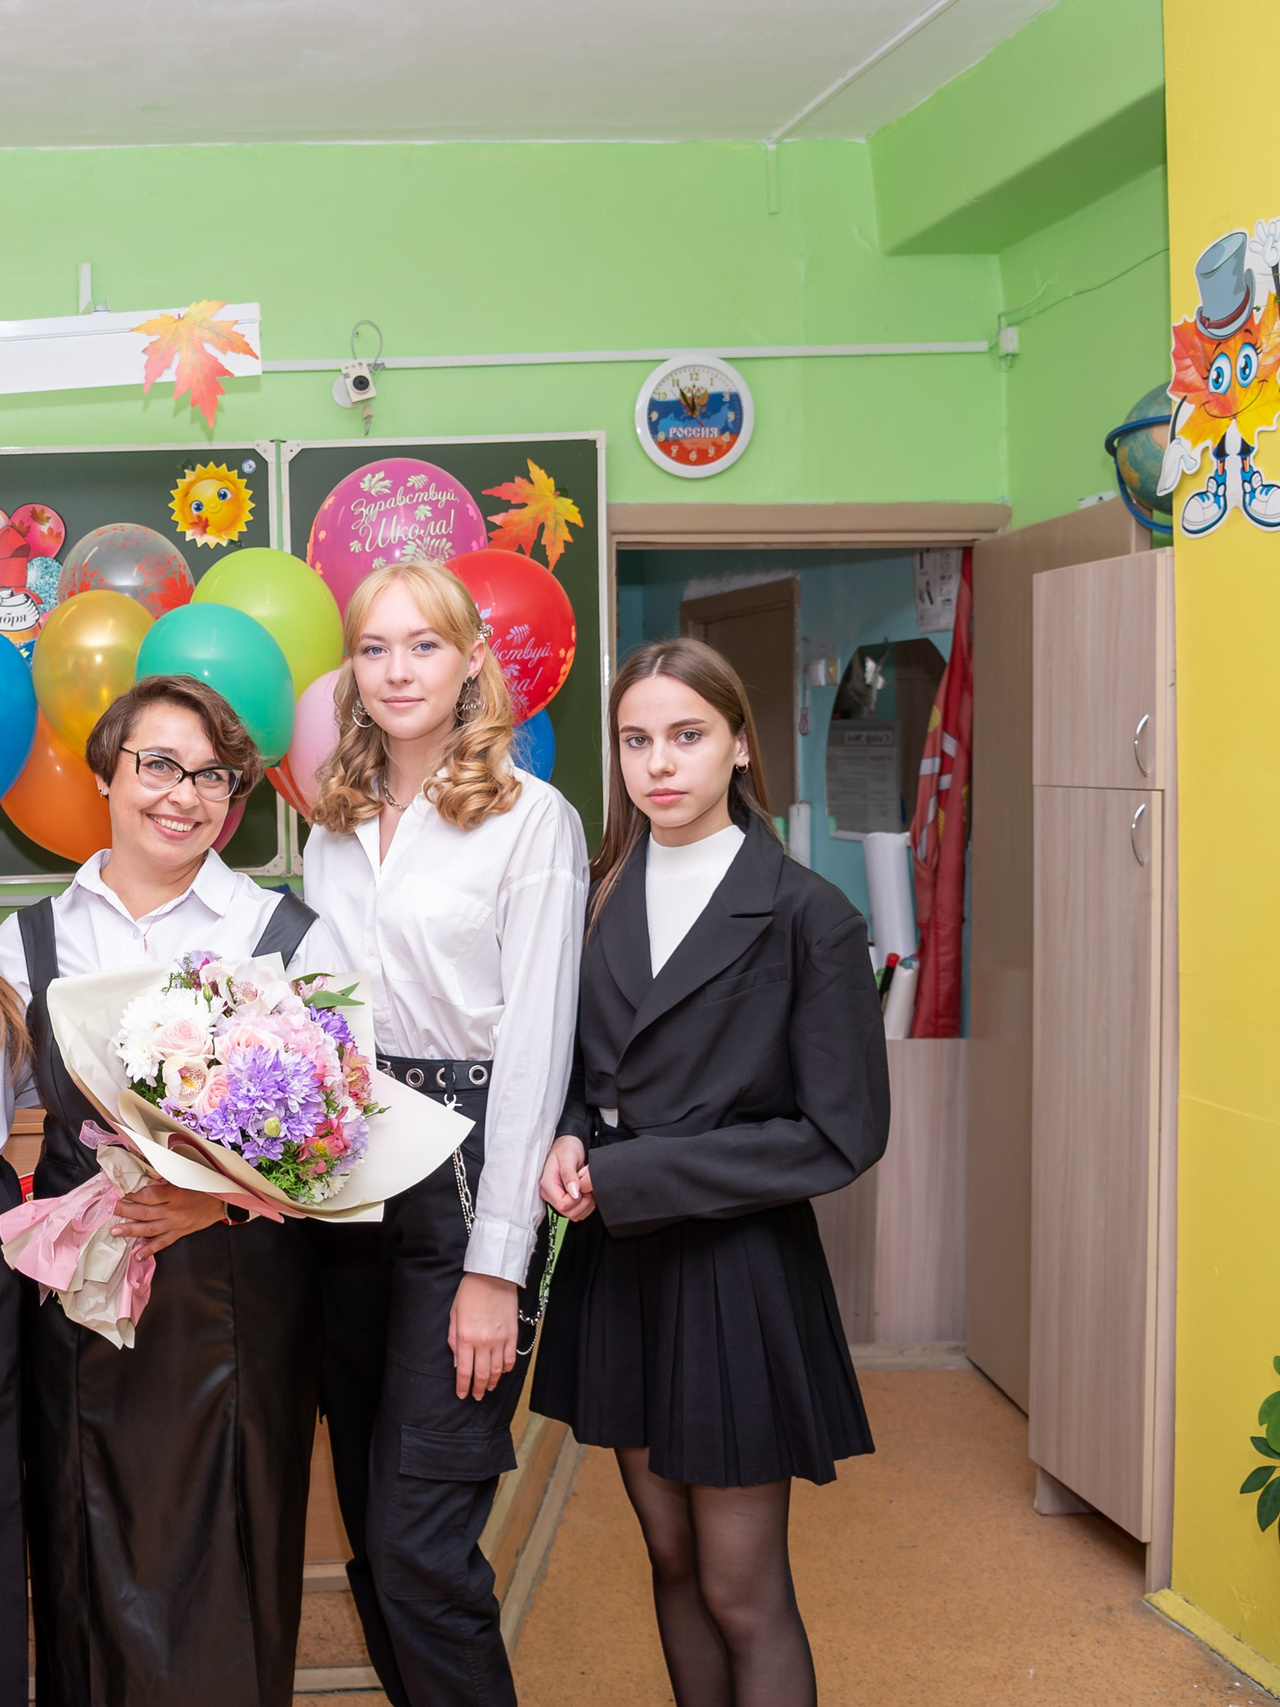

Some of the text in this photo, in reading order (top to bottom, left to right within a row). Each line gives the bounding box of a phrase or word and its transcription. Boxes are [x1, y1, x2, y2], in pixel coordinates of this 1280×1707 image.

[689, 372, 699, 381] 12
[668, 426, 719, 439] РОССИЯ
[351, 482, 460, 531] Здравствуй,
[359, 508, 455, 553] Школа!
